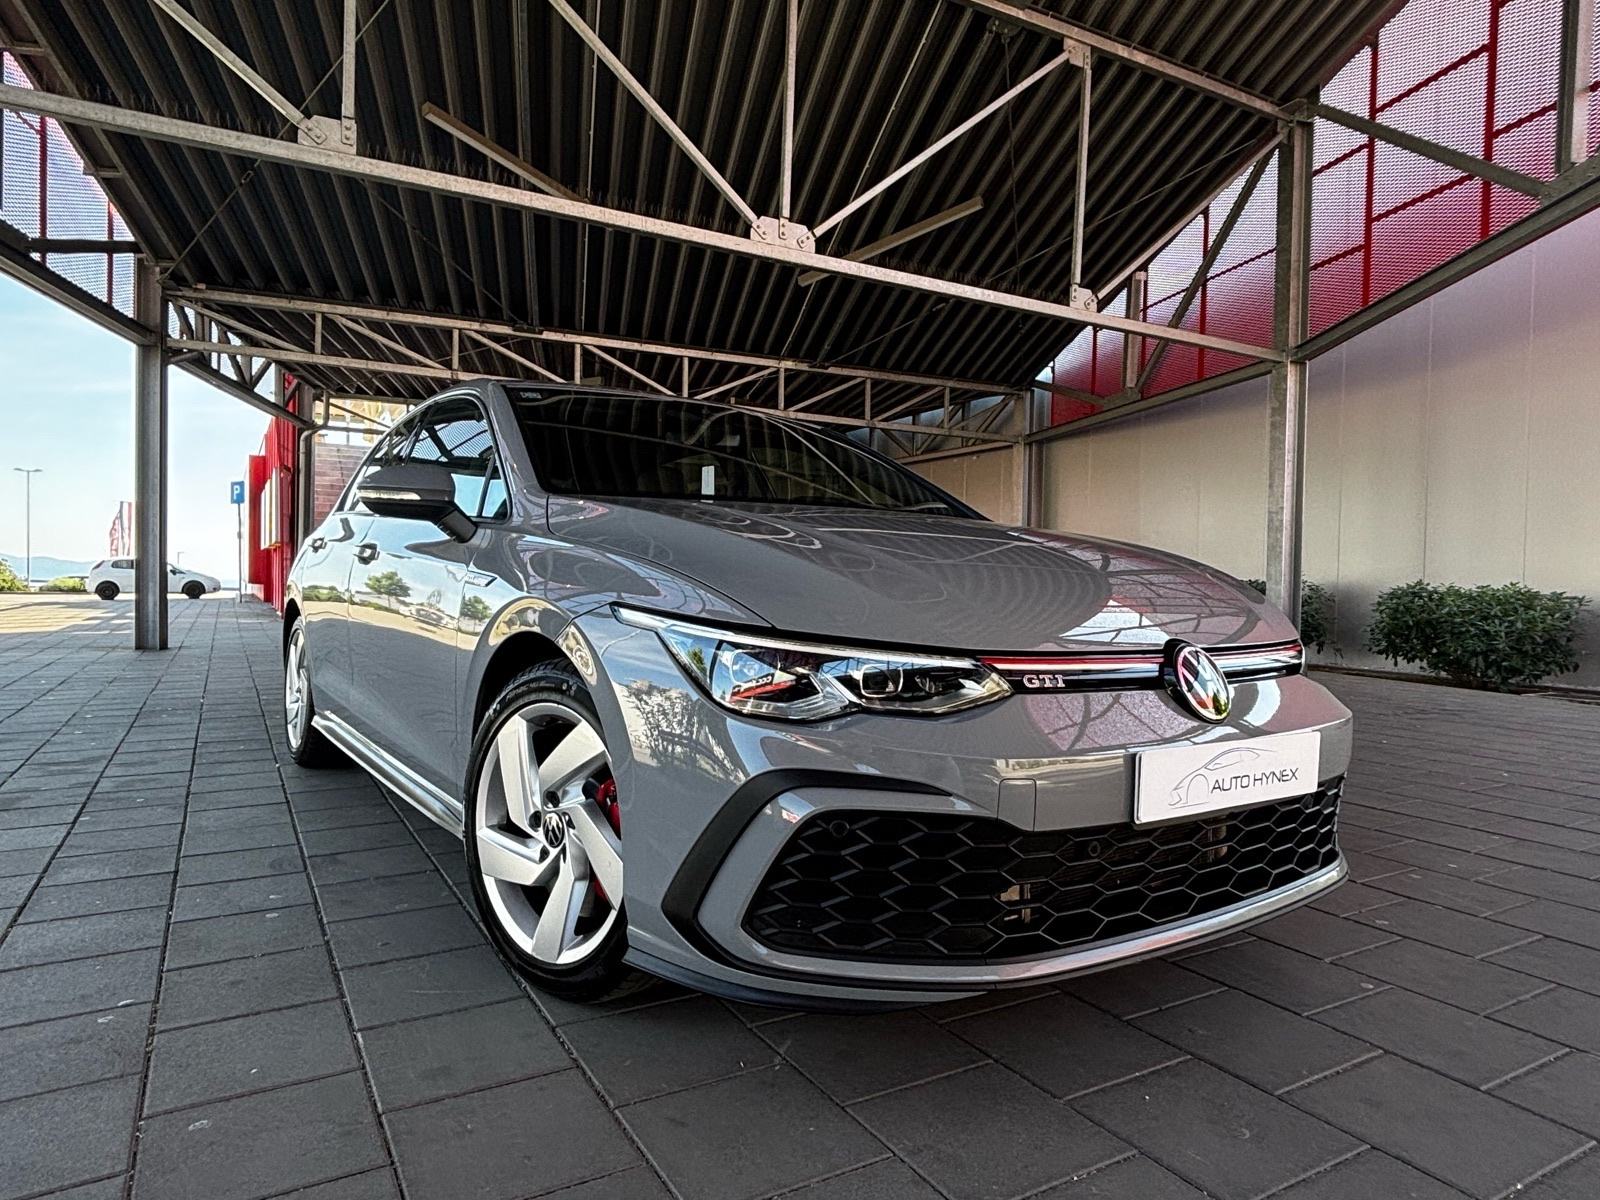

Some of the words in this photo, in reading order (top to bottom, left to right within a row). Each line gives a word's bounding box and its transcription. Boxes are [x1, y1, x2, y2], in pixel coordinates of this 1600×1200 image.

[233, 485, 241, 500] P
[1023, 674, 1066, 688] GTI
[1211, 774, 1251, 794] AUTO
[1253, 767, 1299, 787] HYNEX
